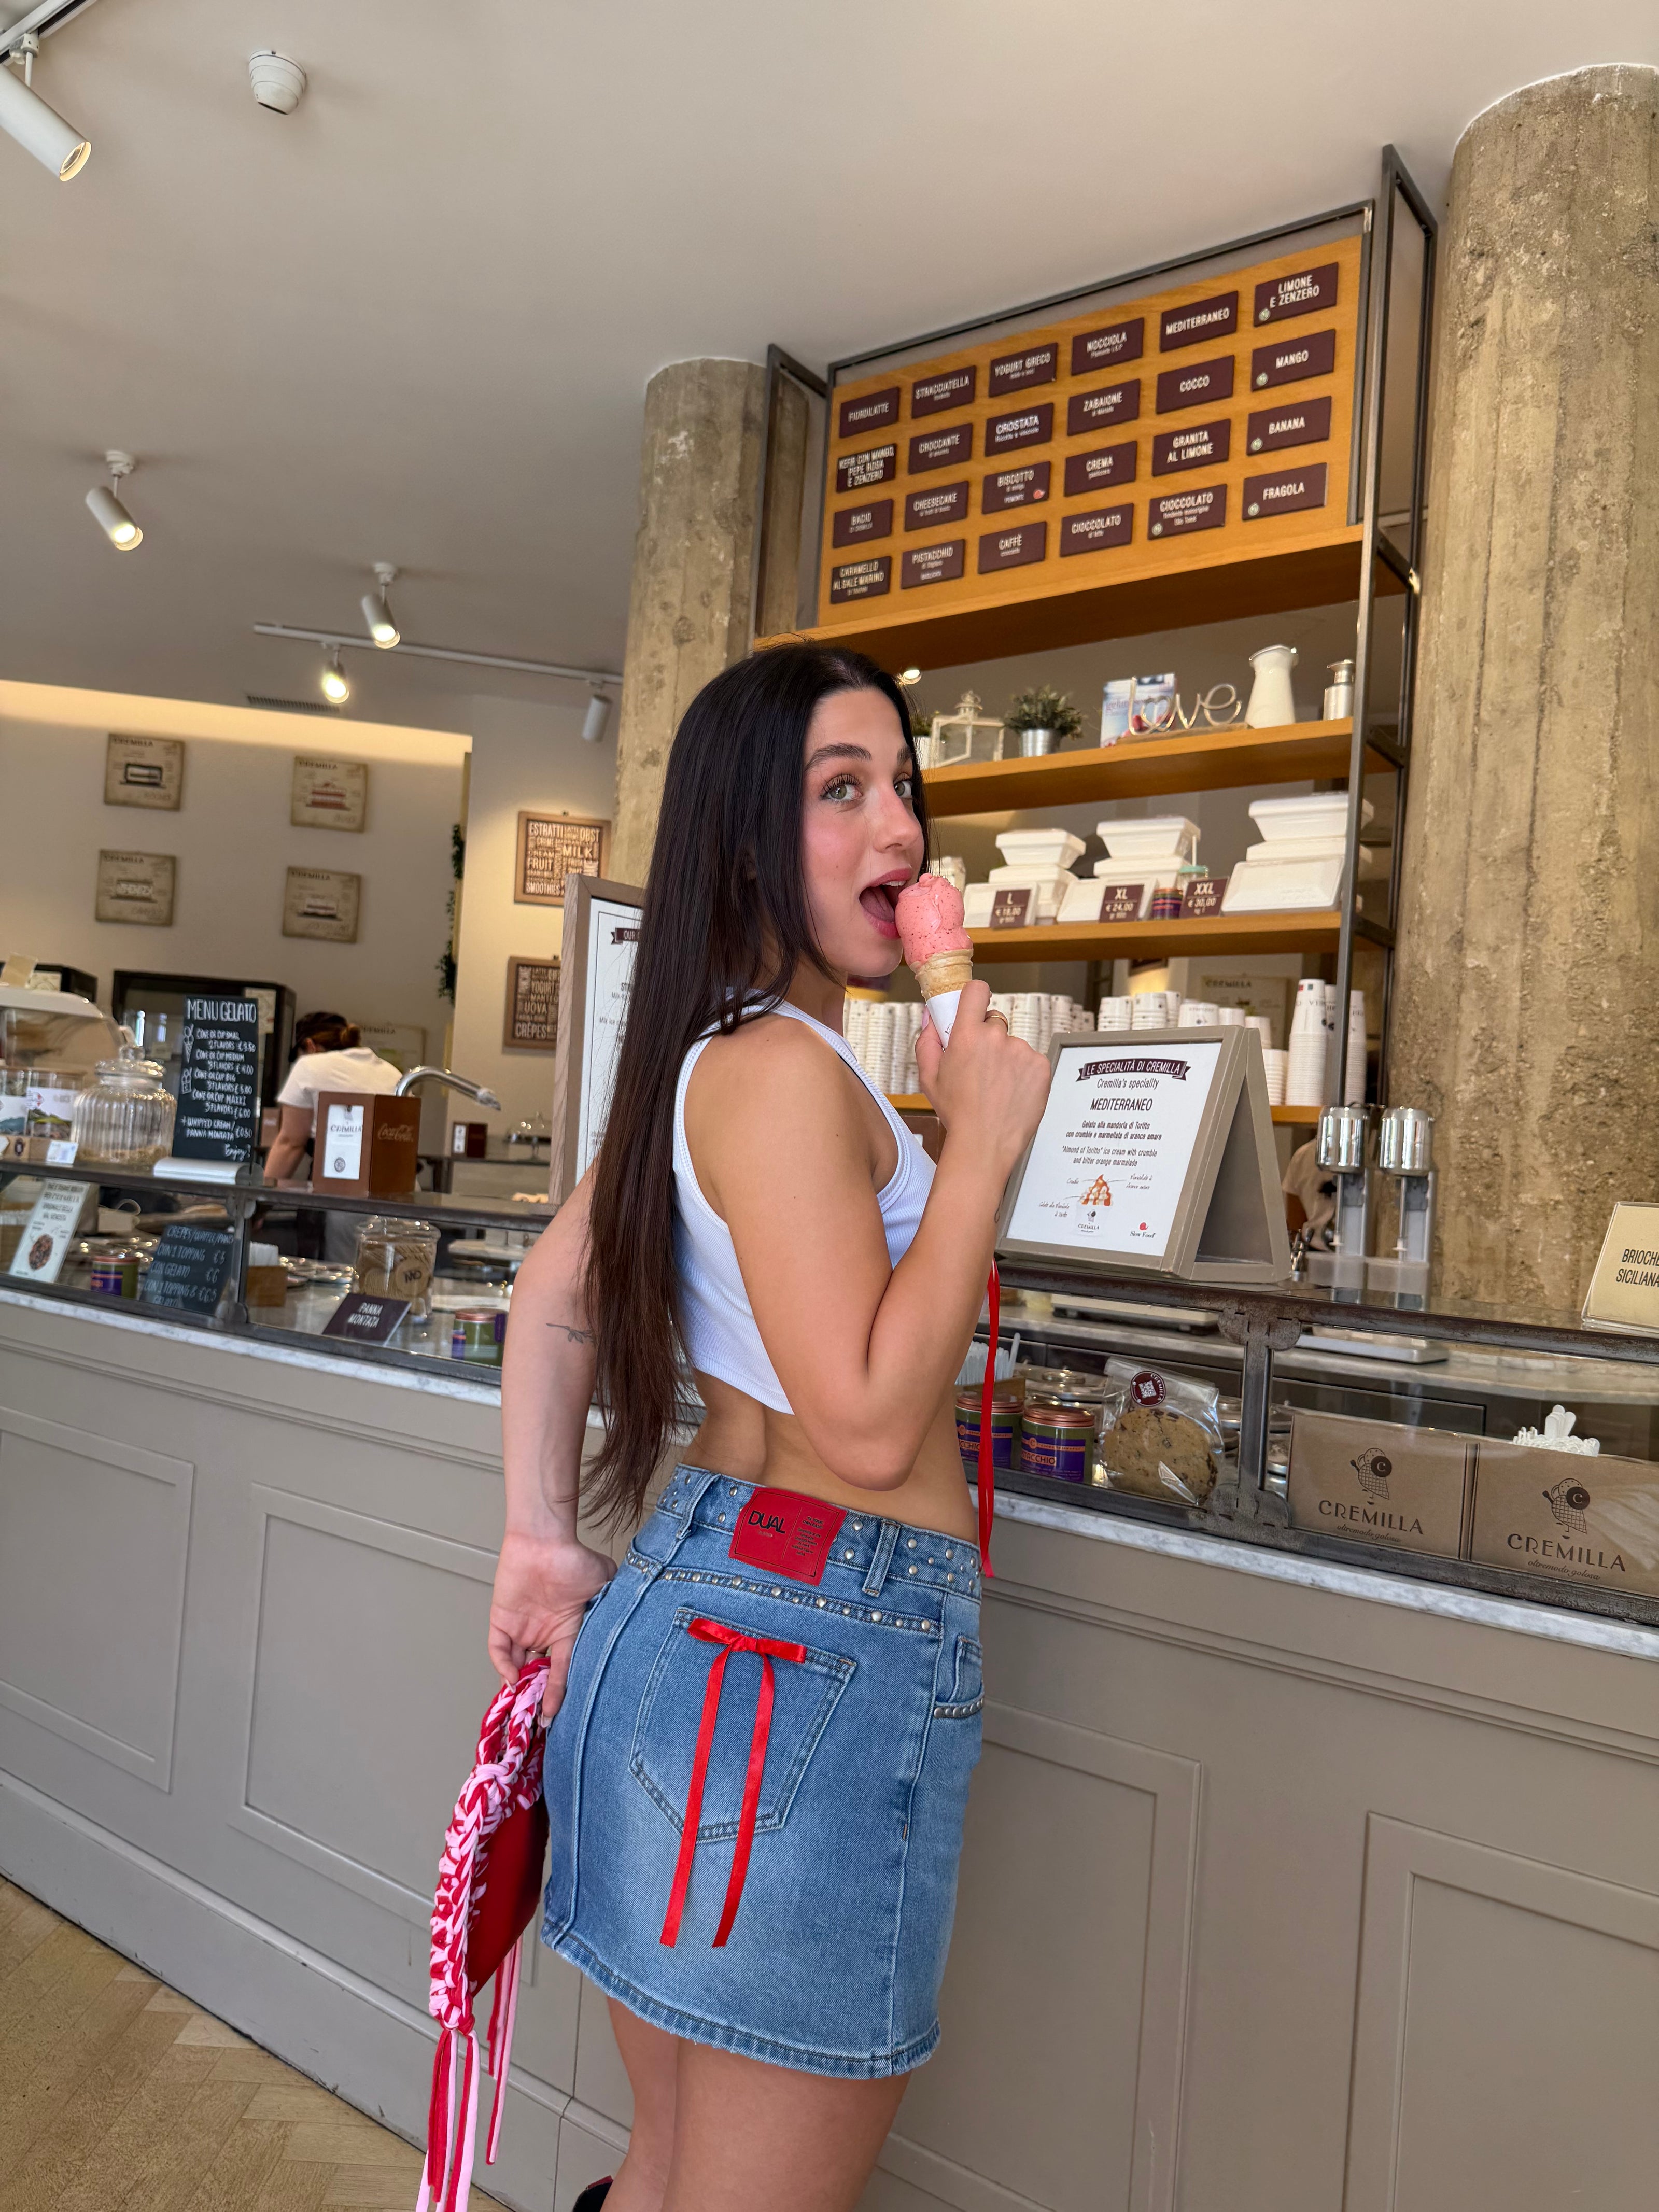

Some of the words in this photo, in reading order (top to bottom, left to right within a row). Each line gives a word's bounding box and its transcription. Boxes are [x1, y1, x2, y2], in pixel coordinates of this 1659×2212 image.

[1278, 274, 1313, 294] LIMONE
[1269, 296, 1276, 308] E
[1278, 285, 1320, 306] ZENZERO
[1165, 307, 1230, 336] MEDITERRANEO
[1087, 331, 1128, 353] NOCCIOLA
[994, 359, 1024, 378] YOGURT
[1024, 351, 1051, 369] GRECO
[1275, 349, 1310, 369] MANGO
[915, 375, 970, 400] STRACCIATELLA
[1179, 375, 1210, 393] COCCO
[1082, 390, 1123, 413] ZABAIONE
[848, 402, 890, 423] FIORDILATTE
[995, 415, 1039, 435] CROSTATA
[1268, 416, 1306, 435] BANANA
[918, 434, 961, 454] CROCCANTE
[1172, 430, 1210, 449] GRANITA
[1166, 450, 1178, 463] AL
[1181, 442, 1214, 460] LIMONE
[847, 464, 865, 477] PEPE
[1086, 455, 1114, 472] CREMA
[855, 470, 883, 486] ZENZERO
[997, 469, 1035, 488] BISCOTTO
[1262, 481, 1305, 501] FRAGOLA
[913, 492, 958, 512] CHEESECAKE
[1160, 491, 1214, 513] CIOCCOLATO
[851, 512, 873, 526] BACIO
[1071, 514, 1122, 534] CIOCCOLATO
[999, 533, 1023, 550] CAFFÈ
[912, 546, 954, 565] PISTACCHIO
[839, 559, 879, 578] CARAMELLO
[529, 821, 564, 838] ESTRATTI
[563, 845, 593, 858] MILK
[527, 857, 553, 871] FRUIT
[525, 882, 560, 896] SMOOTHIES
[1114, 887, 1128, 900] XL
[1193, 882, 1215, 895] XXL
[1006, 892, 1014, 905] L
[623, 929, 636, 940] OUR
[187, 998, 219, 1021] MENU
[220, 1000, 257, 1023] GELATO
[524, 1000, 547, 1015] UOVA
[196, 1028, 208, 1040] CONE
[209, 1028, 216, 1038] OR
[217, 1029, 226, 1040] CUP
[226, 1031, 240, 1041] SMALL
[214, 1040, 235, 1050] FLAVORS
[195, 1048, 208, 1060] CONE
[209, 1049, 216, 1060] OR
[216, 1050, 226, 1061] CUP
[226, 1051, 245, 1062] MEDIUM
[214, 1061, 234, 1072] FLAVORS
[1087, 1064, 1096, 1075] LE
[1097, 1059, 1135, 1074] SPECIALITÀ
[1136, 1062, 1145, 1072] DI
[1146, 1061, 1180, 1074] CREMILLA
[194, 1068, 208, 1080] CONE
[208, 1071, 215, 1080] OR
[215, 1071, 225, 1081] CUP
[226, 1072, 236, 1083] BIG
[1097, 1078, 1127, 1088] Cremilla's
[1128, 1078, 1159, 1090] speciality
[211, 1080, 234, 1092] FLAVORS
[192, 1088, 206, 1100] CONE
[207, 1091, 214, 1102] OR
[214, 1092, 225, 1103] CUP
[226, 1094, 247, 1106] MAXXI
[1090, 1098, 1153, 1111] MEDITERRANEO
[210, 1103, 233, 1115] FLAVORS
[187, 1116, 213, 1129] WHIPPED
[213, 1119, 231, 1129] CREAM
[1081, 1120, 1096, 1129] Gelato
[1135, 1121, 1150, 1130] Toritto
[186, 1128, 207, 1138] PANNA
[208, 1129, 234, 1141] MONTATA
[1098, 1131, 1122, 1139] marmellata
[1080, 1146, 1086, 1154] of
[1137, 1149, 1158, 1157] crumble
[1095, 1158, 1112, 1166] orange
[1112, 1158, 1138, 1167] marmalade
[157, 1243, 171, 1256] CON
[178, 1245, 206, 1262] TOPPING
[150, 1260, 166, 1275] CON
[164, 1262, 191, 1278] GELATO
[164, 1280, 190, 1297] TOPPING
[359, 1302, 384, 1316] PANNA
[347, 1313, 381, 1329] MONTATA
[1376, 1461, 1386, 1472] C
[1573, 1493, 1583, 1503] C
[748, 1510, 786, 1534] DUAL
[1318, 1500, 1424, 1535] CREMILLA
[1337, 1523, 1374, 1540] oltremodo
[1372, 1531, 1401, 1543] golosa
[1507, 1533, 1626, 1572] CREMILLA
[1527, 1559, 1569, 1574] oltremodo
[1568, 1569, 1601, 1581] golosa
